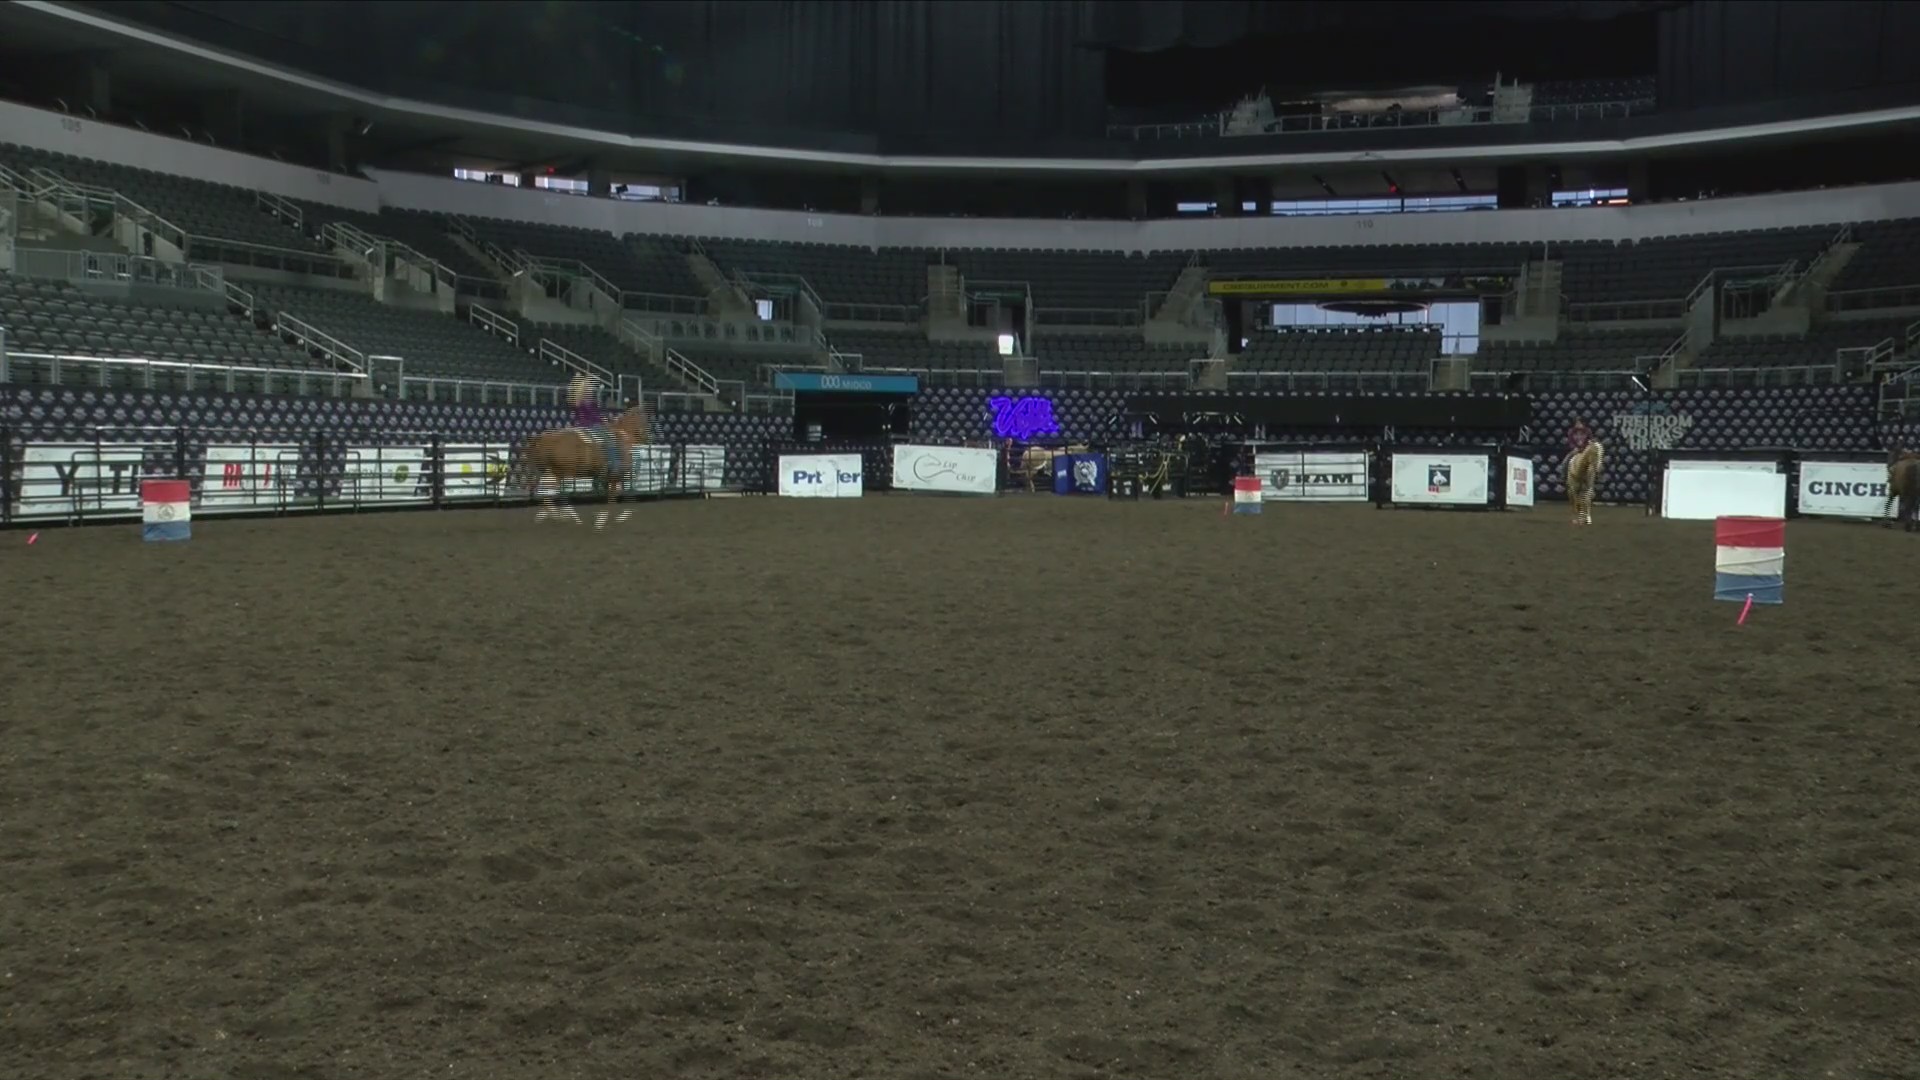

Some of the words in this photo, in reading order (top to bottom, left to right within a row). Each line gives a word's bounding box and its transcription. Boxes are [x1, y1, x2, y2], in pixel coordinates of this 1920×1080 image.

[842, 380, 872, 390] MIDCO
[1612, 414, 1693, 427] FREEDOM
[1621, 425, 1684, 439] WORKS
[1295, 474, 1353, 484] RAM
[1808, 481, 1887, 497] CINCH
